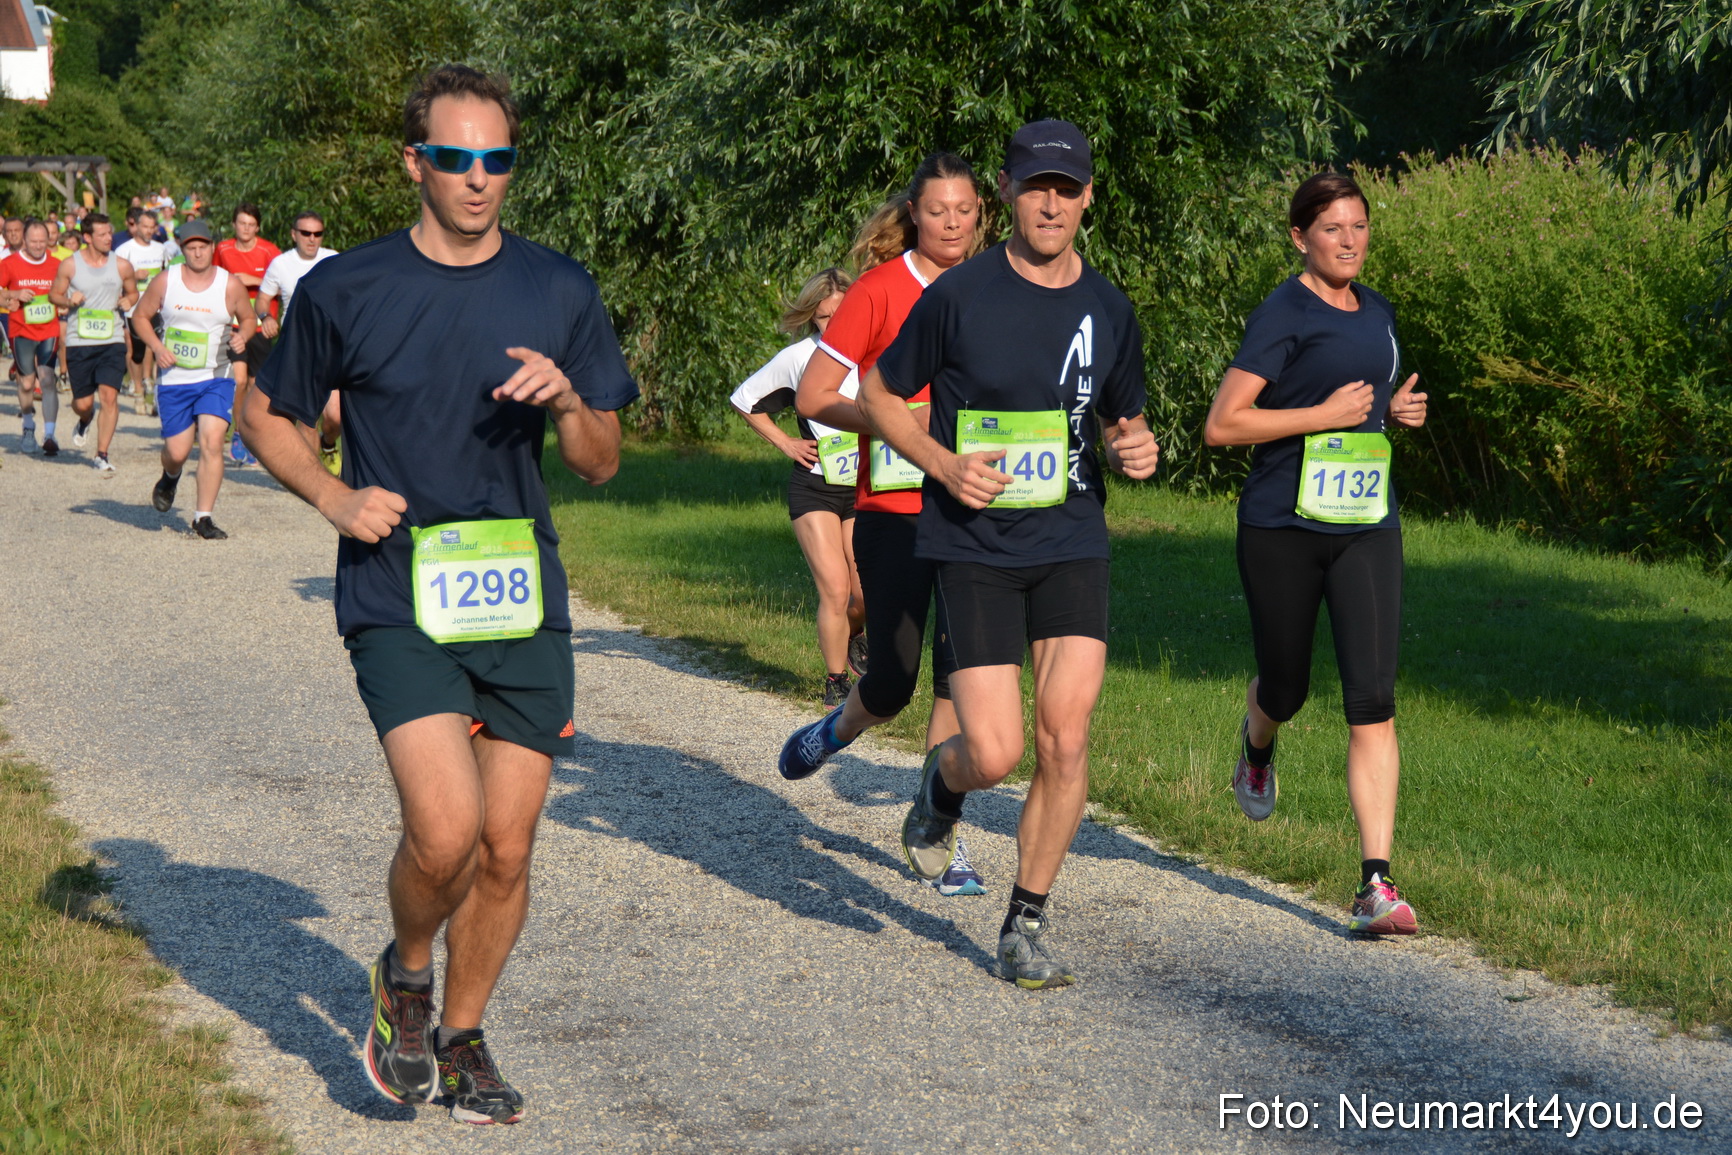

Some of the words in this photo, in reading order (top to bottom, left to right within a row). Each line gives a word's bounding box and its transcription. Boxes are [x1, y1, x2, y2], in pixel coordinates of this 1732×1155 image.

[28, 306, 52, 316] 1401
[86, 320, 107, 331] 362
[173, 343, 198, 359] 580
[1313, 469, 1380, 498] 1132
[1340, 503, 1368, 512] Moosburger
[433, 541, 478, 551] firmenlauf
[430, 567, 530, 609] 1298
[452, 616, 488, 625] Johannes
[489, 614, 513, 622] Merkel
